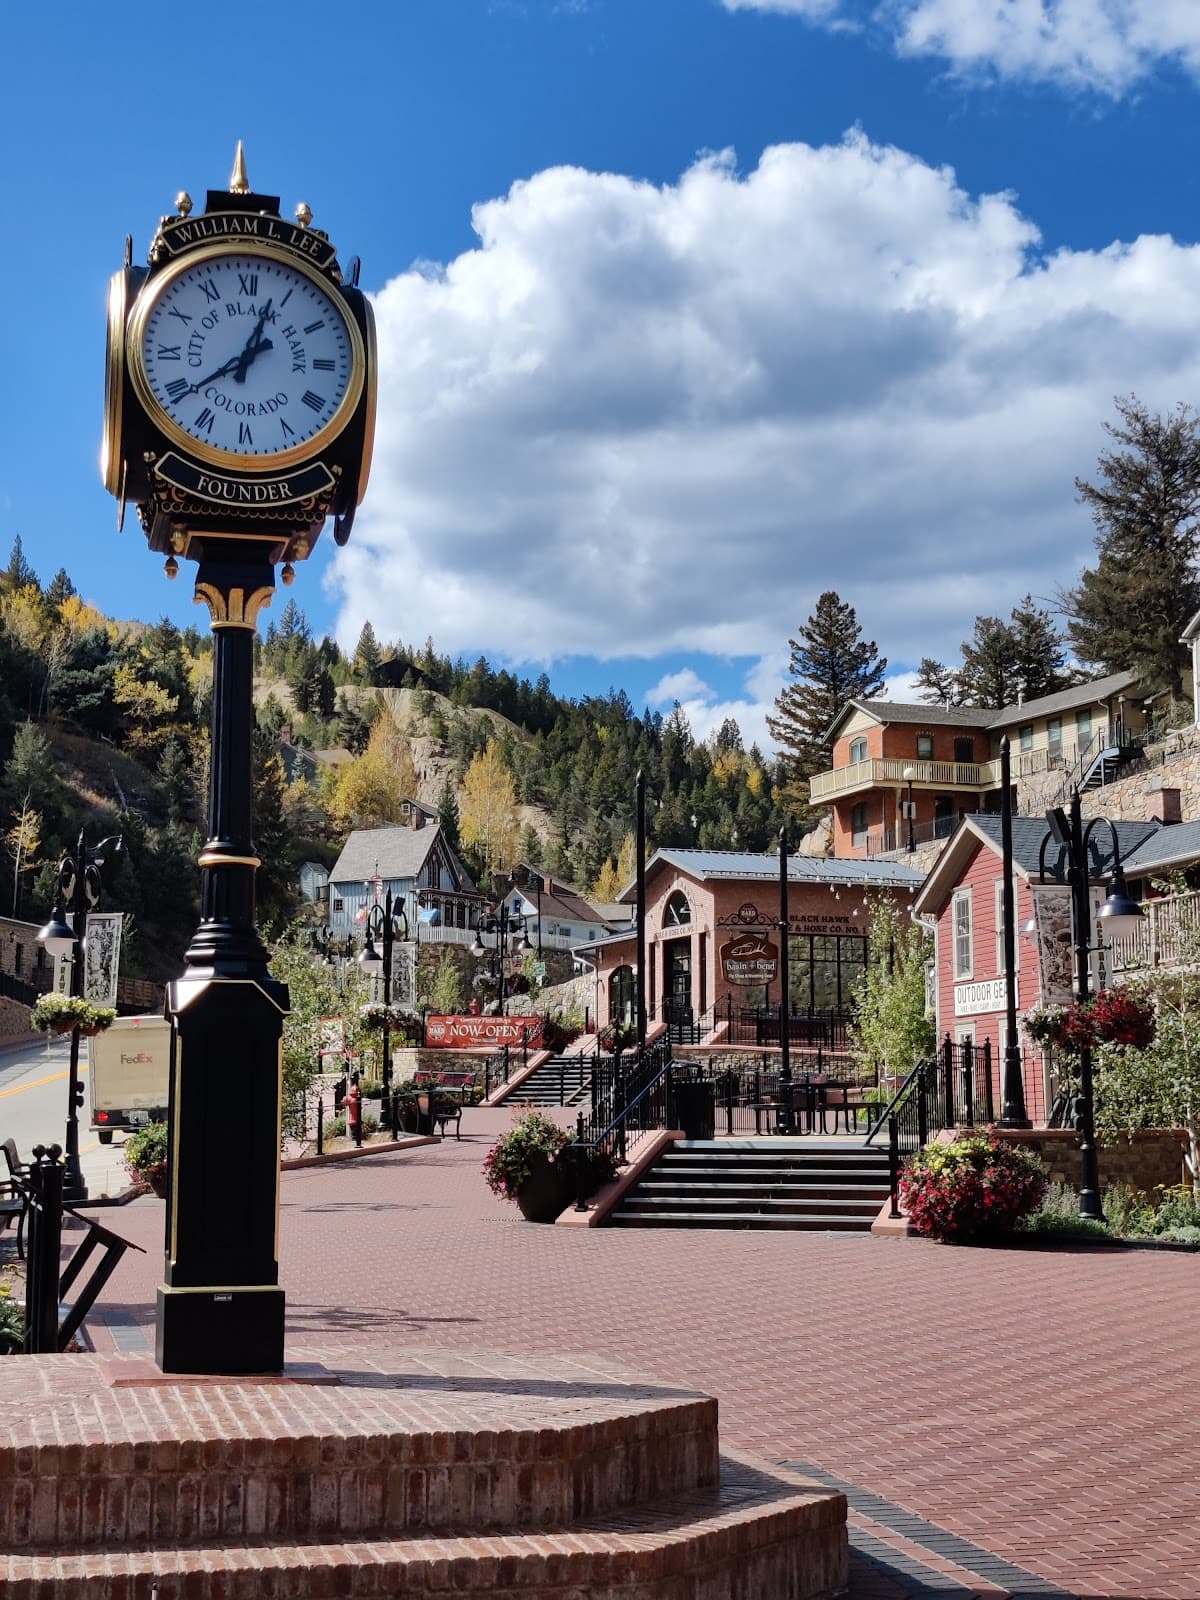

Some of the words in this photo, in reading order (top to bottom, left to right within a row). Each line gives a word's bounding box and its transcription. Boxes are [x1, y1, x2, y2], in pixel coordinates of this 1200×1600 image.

[175, 217, 258, 243] WILLIAM
[268, 222, 280, 239] L.
[290, 230, 322, 257] LEE
[197, 279, 221, 304] XI
[238, 273, 258, 297] XII
[167, 305, 192, 326] X
[187, 329, 206, 367] CITY
[201, 309, 220, 330] OF
[225, 302, 282, 326] BLACK
[281, 324, 306, 374] HAWK
[303, 320, 326, 335] II
[157, 343, 182, 360] IX
[312, 359, 336, 371] III
[204, 386, 289, 416] COLORADO
[194, 407, 216, 434] VII
[279, 416, 295, 439] V
[238, 421, 253, 446] VI
[197, 475, 294, 501] FOUNDER
[789, 915, 819, 923] BLACK
[821, 916, 850, 924] HAWK
[803, 925, 828, 933] HOSE
[726, 961, 747, 971] basin
[756, 960, 775, 971] bend
[957, 983, 992, 1005] OUTDOOR
[120, 1053, 153, 1064] FedEx
